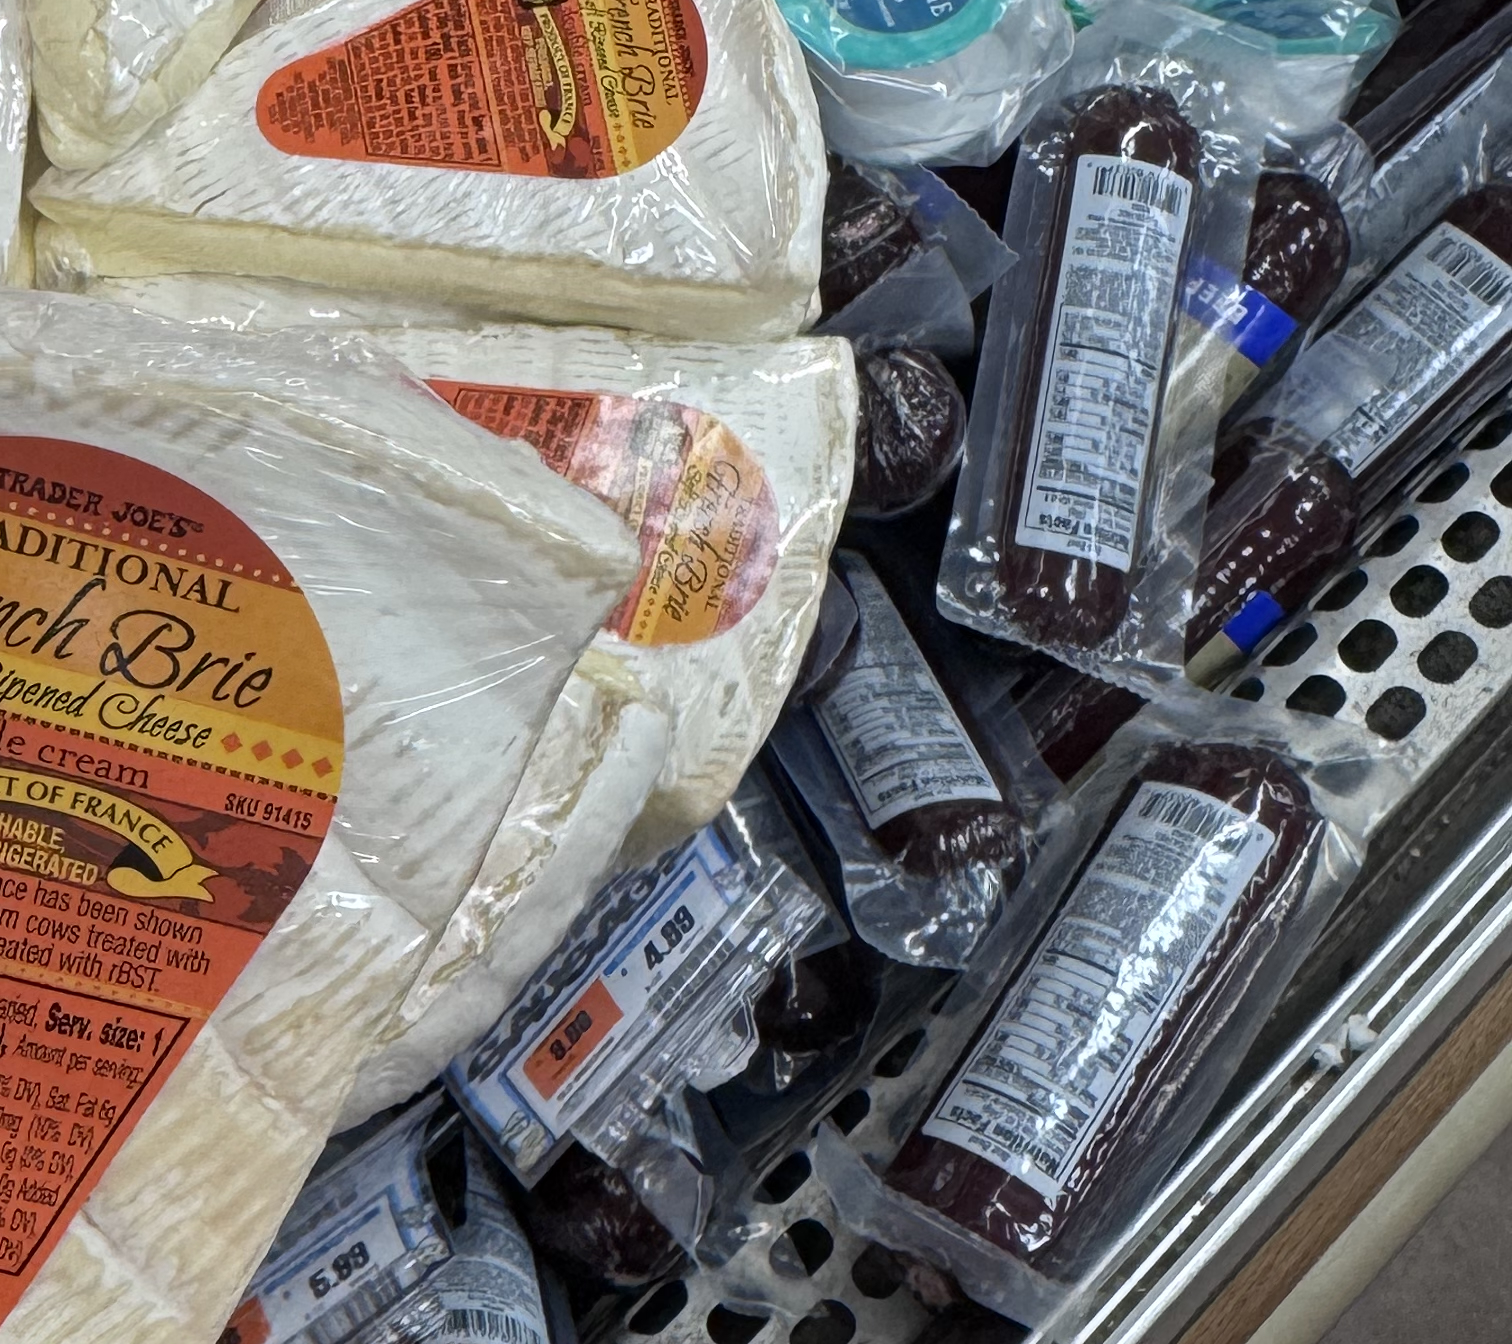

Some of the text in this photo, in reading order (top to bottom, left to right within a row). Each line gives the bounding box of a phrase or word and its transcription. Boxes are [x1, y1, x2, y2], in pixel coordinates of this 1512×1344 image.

[618, 65, 656, 128] Brie
[662, 554, 707, 622] Brie
[100, 610, 272, 708] Brie
[98, 693, 212, 748] Cheese
[38, 745, 148, 789] cream
[27, 781, 65, 803] OF
[63, 792, 179, 855] FRANCE
[225, 793, 261, 817] SKU
[34, 881, 71, 911] has
[77, 892, 133, 926] been
[134, 909, 202, 944] shown
[26, 915, 80, 944] cows
[87, 924, 162, 963] treated
[167, 949, 210, 975] with
[60, 951, 102, 981] with
[99, 1020, 145, 1051] size:
